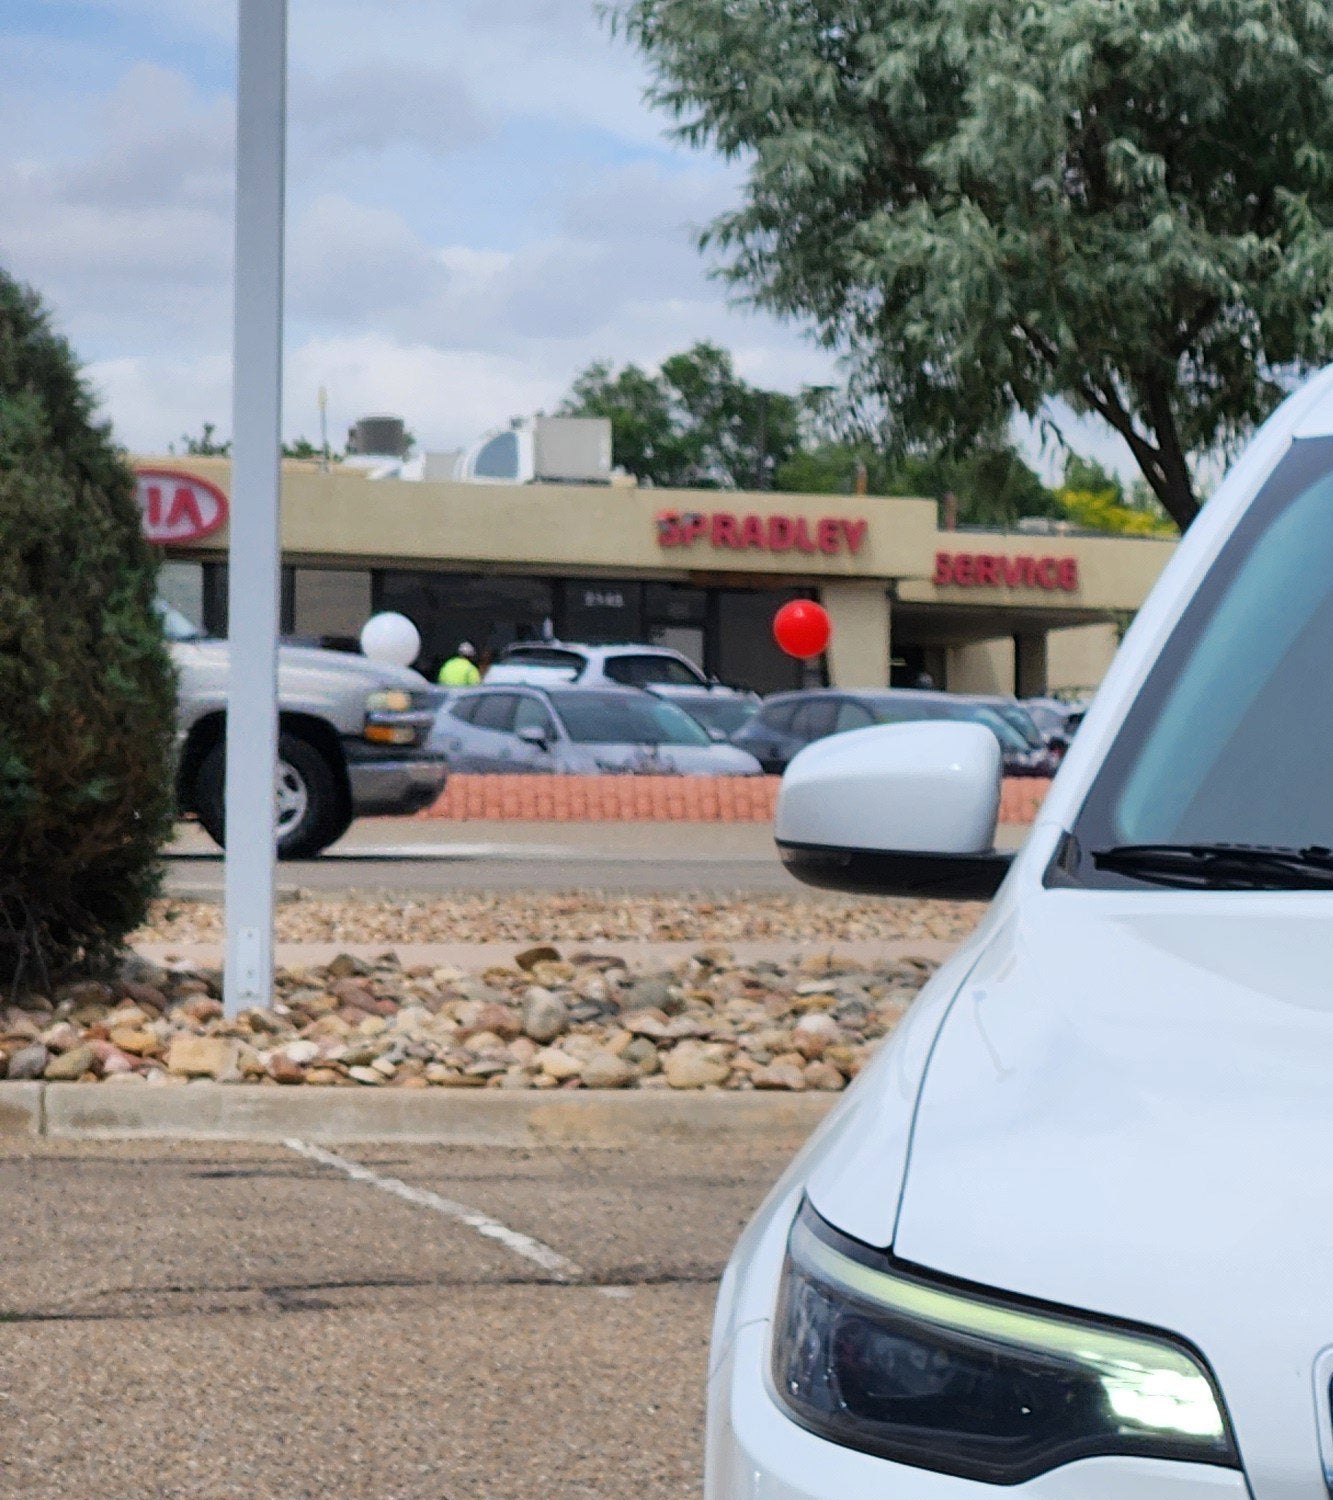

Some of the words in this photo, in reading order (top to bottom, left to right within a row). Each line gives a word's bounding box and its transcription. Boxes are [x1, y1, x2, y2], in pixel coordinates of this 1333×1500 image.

[145, 485, 205, 529] IA
[656, 511, 868, 555] SPRADLEY
[934, 551, 1079, 592] SERVICE
